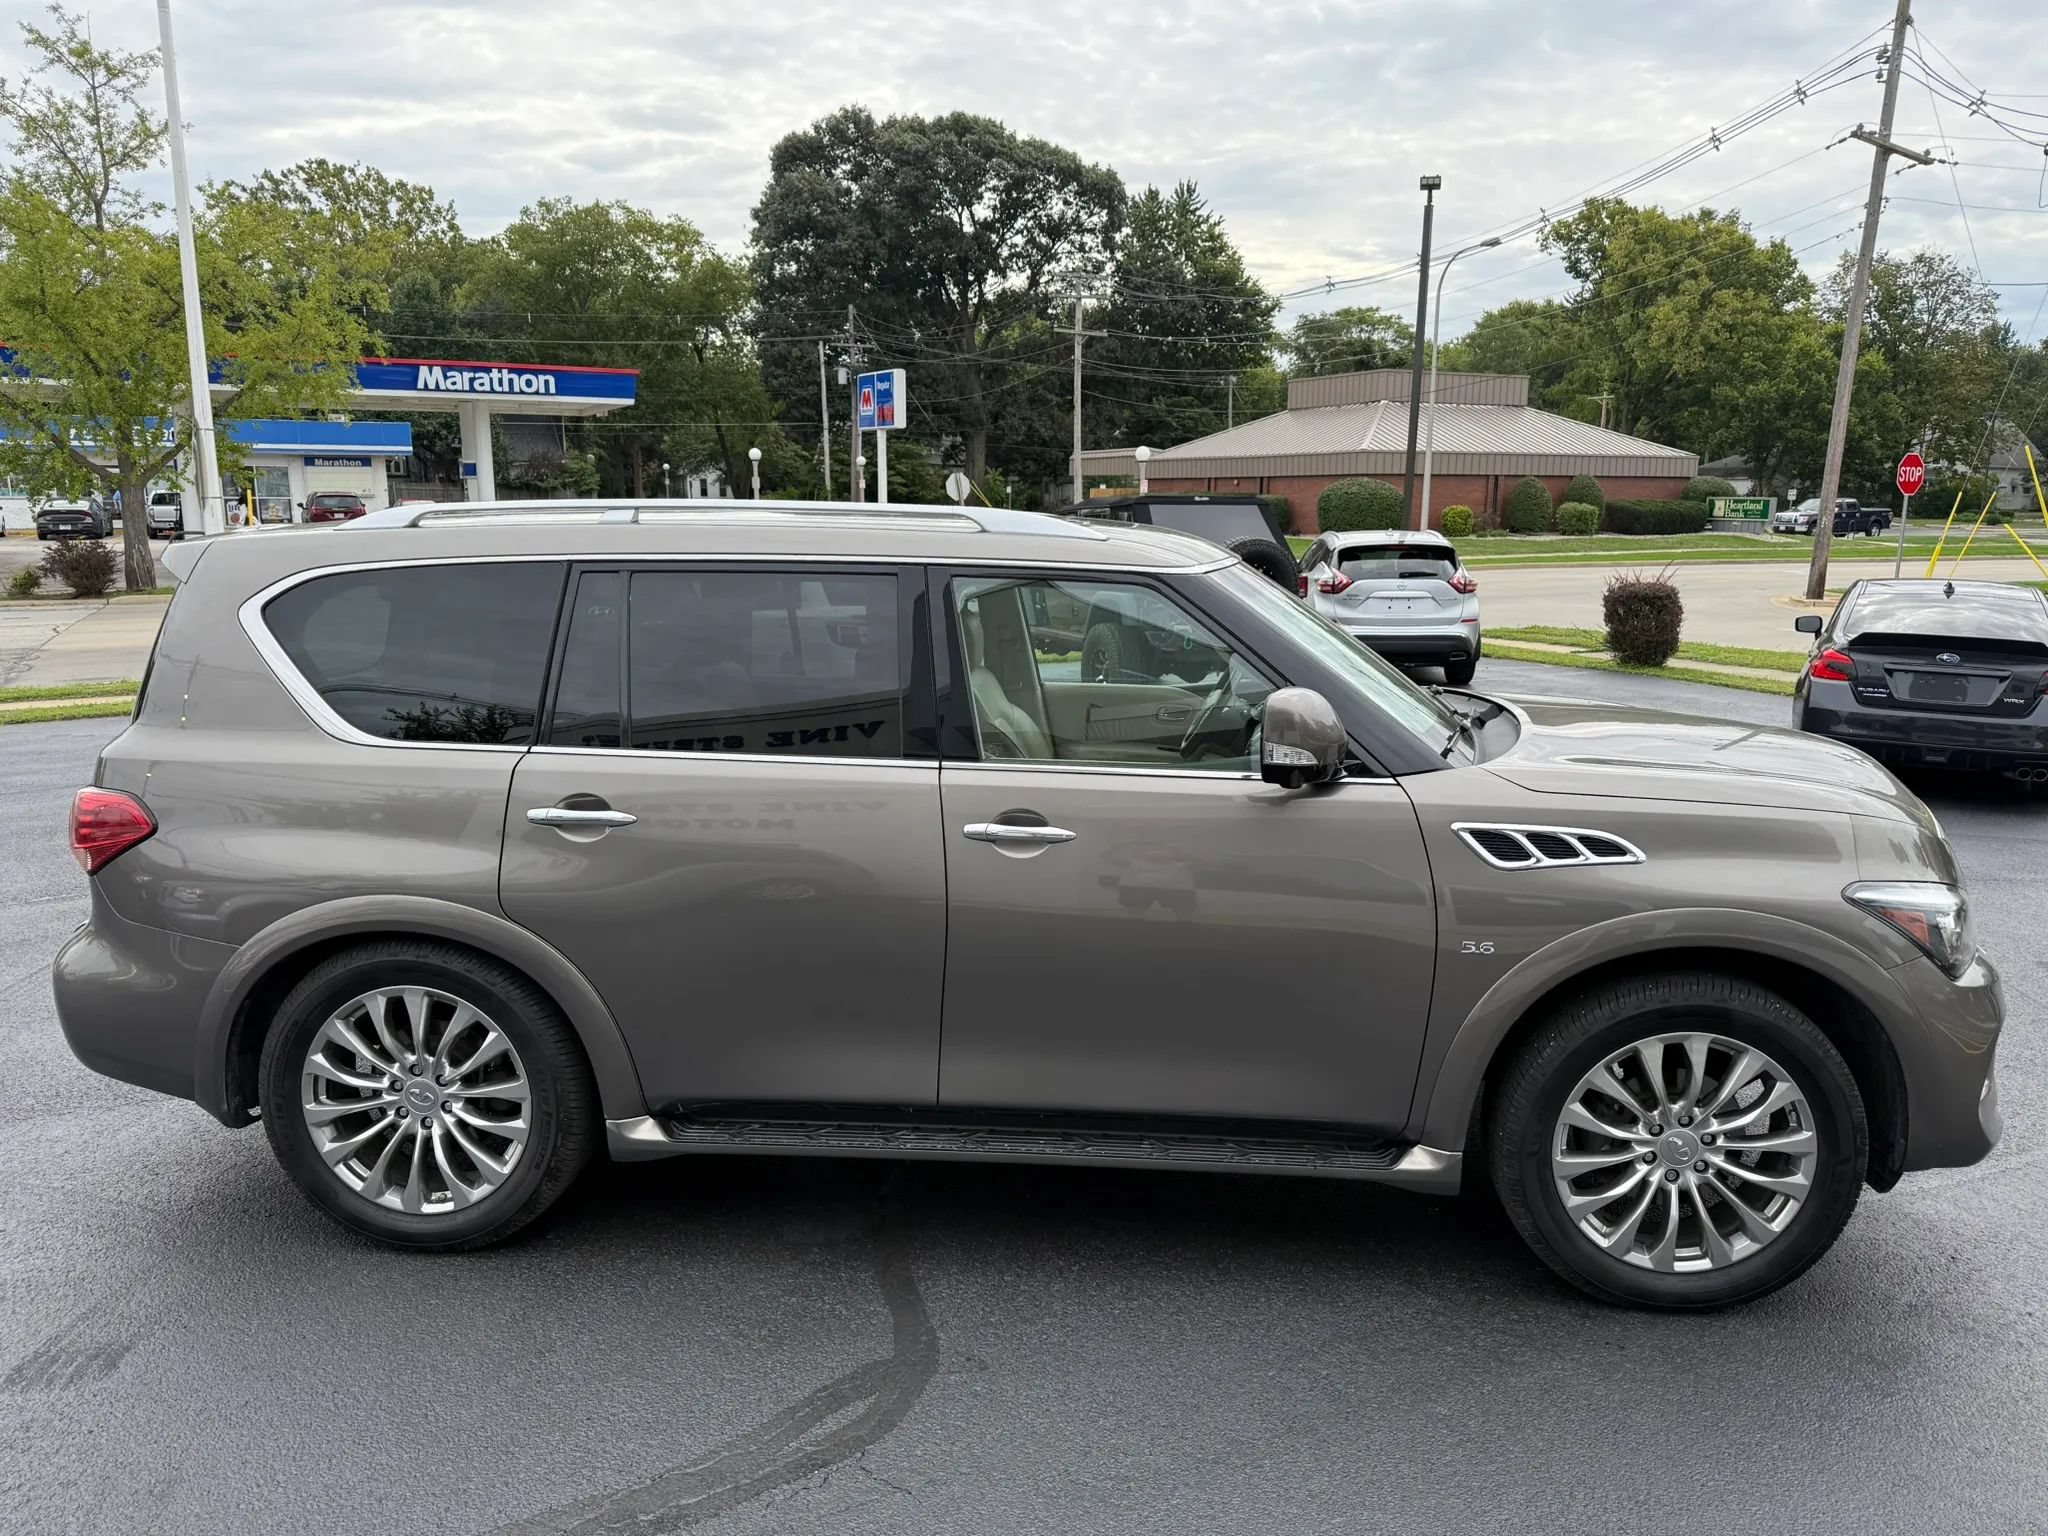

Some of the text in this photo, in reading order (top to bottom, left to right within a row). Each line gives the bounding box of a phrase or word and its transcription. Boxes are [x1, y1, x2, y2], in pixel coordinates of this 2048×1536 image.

[417, 365, 556, 394] Marathon
[314, 458, 362, 467] Marathon
[1900, 466, 1922, 482] STOP
[1726, 500, 1763, 509] Heartland
[1725, 509, 1745, 518] Bank
[1461, 940, 1495, 954] 5.6
